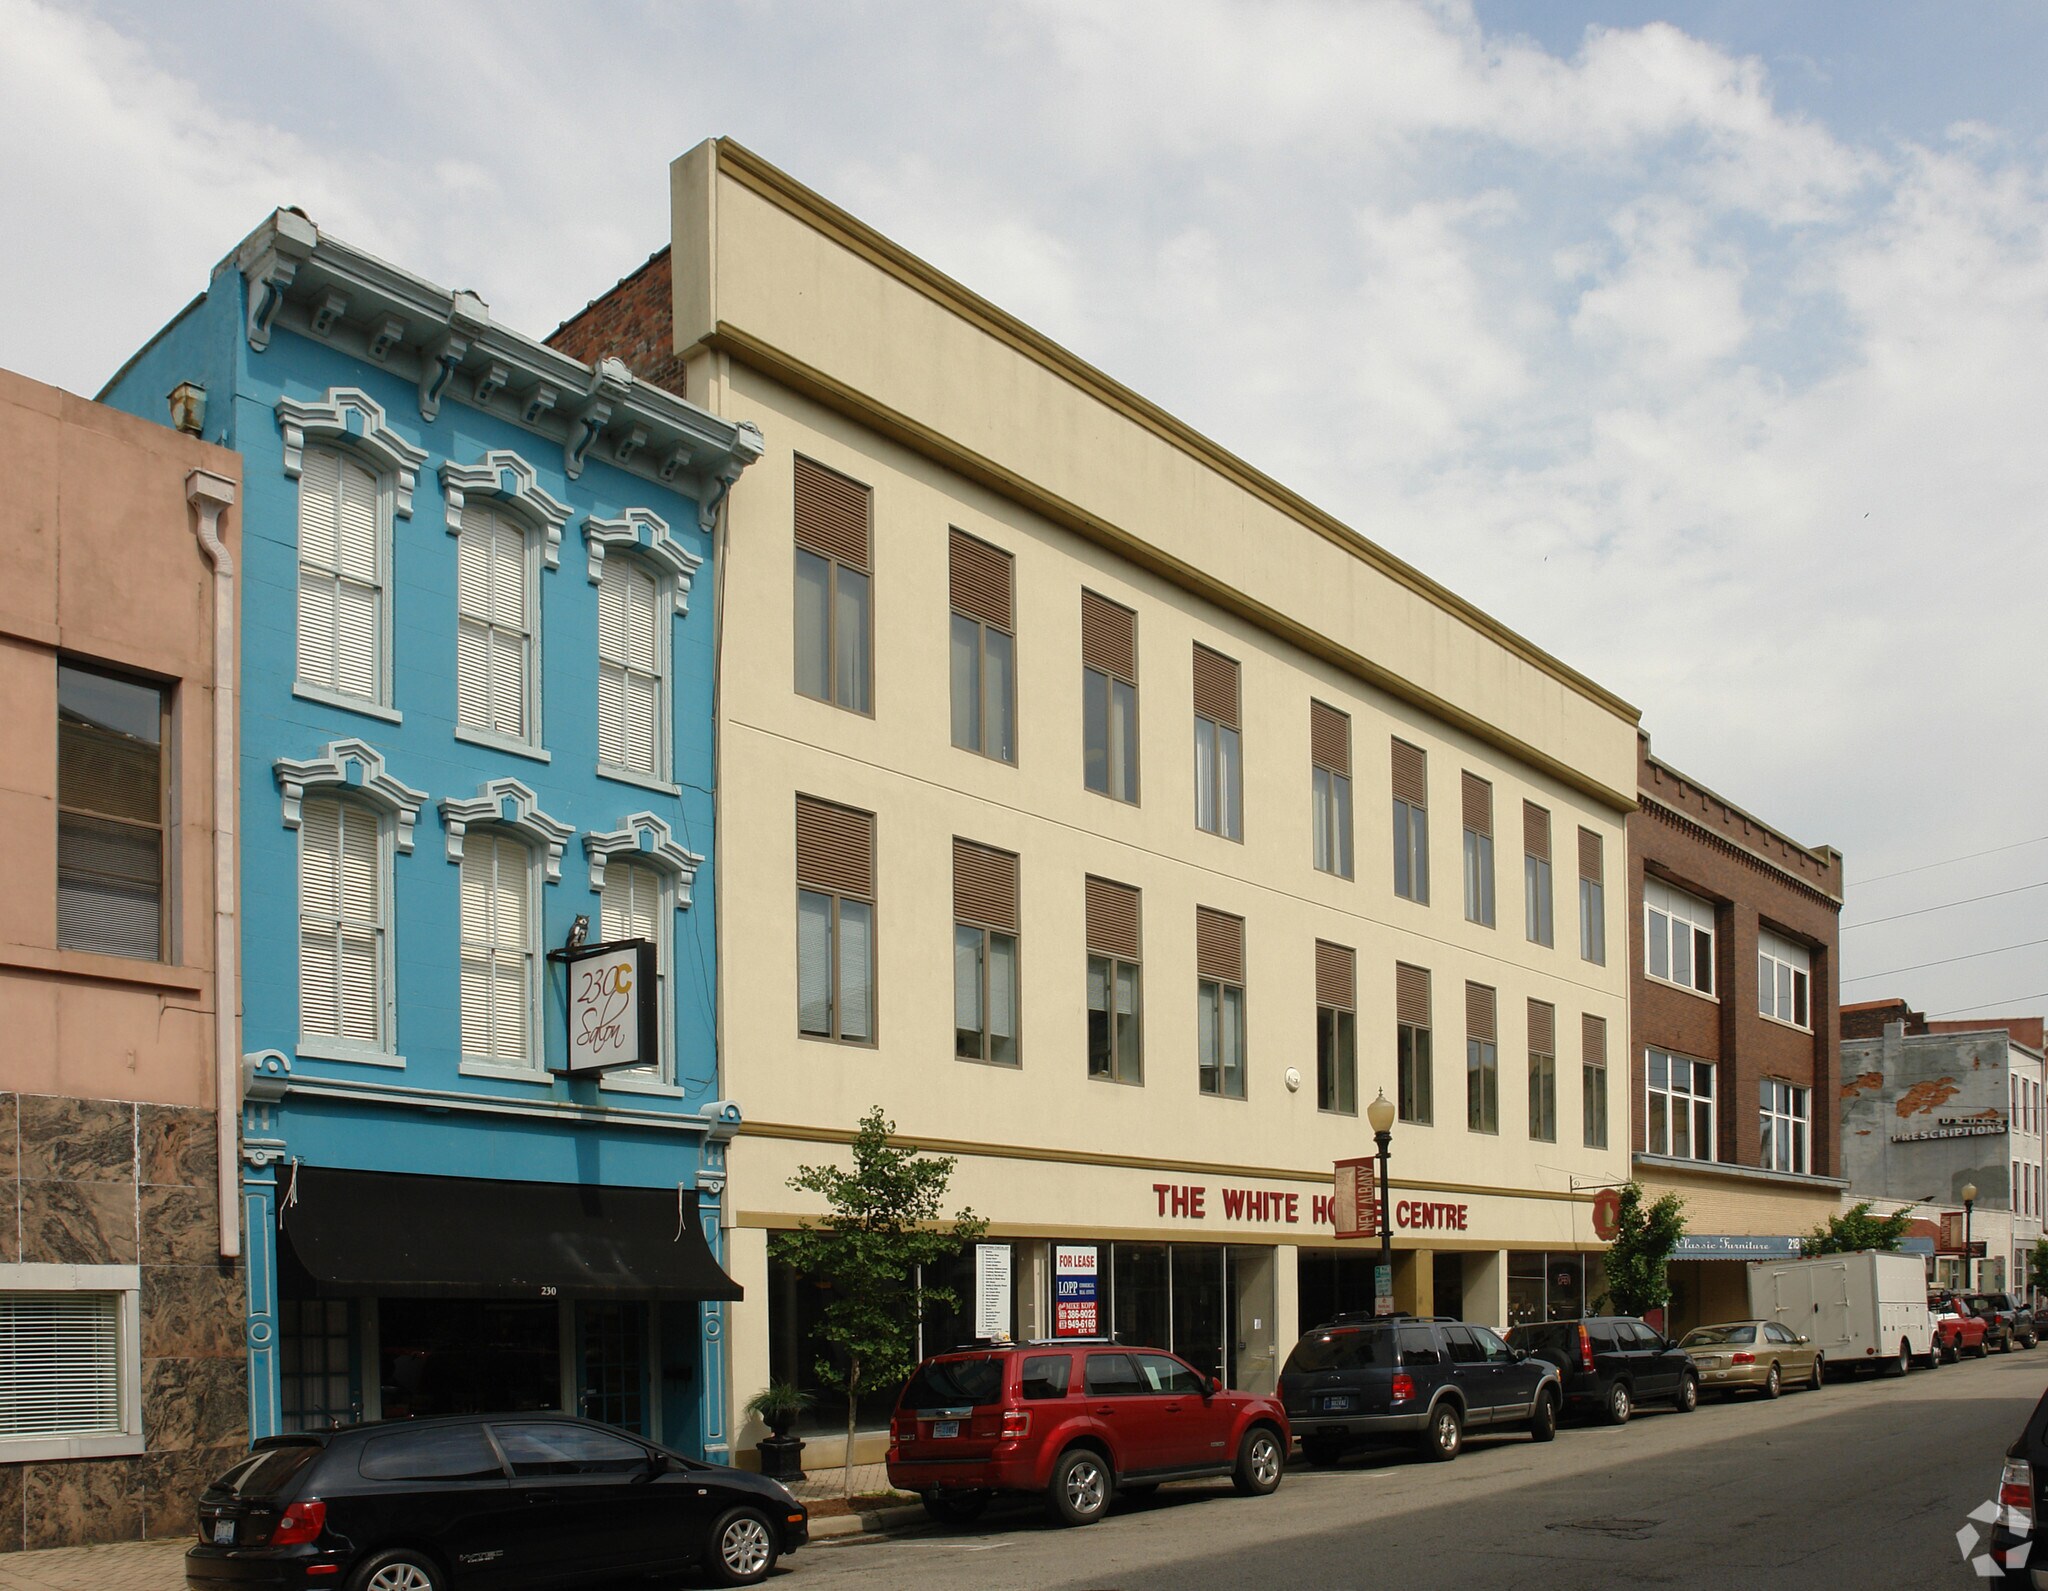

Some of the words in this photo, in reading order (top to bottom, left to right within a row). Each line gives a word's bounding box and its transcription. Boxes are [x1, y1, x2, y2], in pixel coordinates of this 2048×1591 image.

[576, 990, 629, 1053] Salon
[1892, 1125, 2006, 1142] PRESCRIPTIONS
[1357, 1166, 1374, 1204] ALBANY
[1153, 1184, 1206, 1219] THE
[1222, 1188, 1299, 1223] WHITE
[1313, 1195, 1382, 1227] HOE
[1396, 1200, 1468, 1230] CENTRE
[1358, 1209, 1375, 1231] NEW
[1675, 1237, 1717, 1249] Classic
[1719, 1237, 1770, 1250] Furniture
[1059, 1255, 1073, 1268] FOR
[1074, 1255, 1095, 1268] LEASE
[541, 1286, 557, 1296] 230
[1058, 1281, 1078, 1294] LOPP
